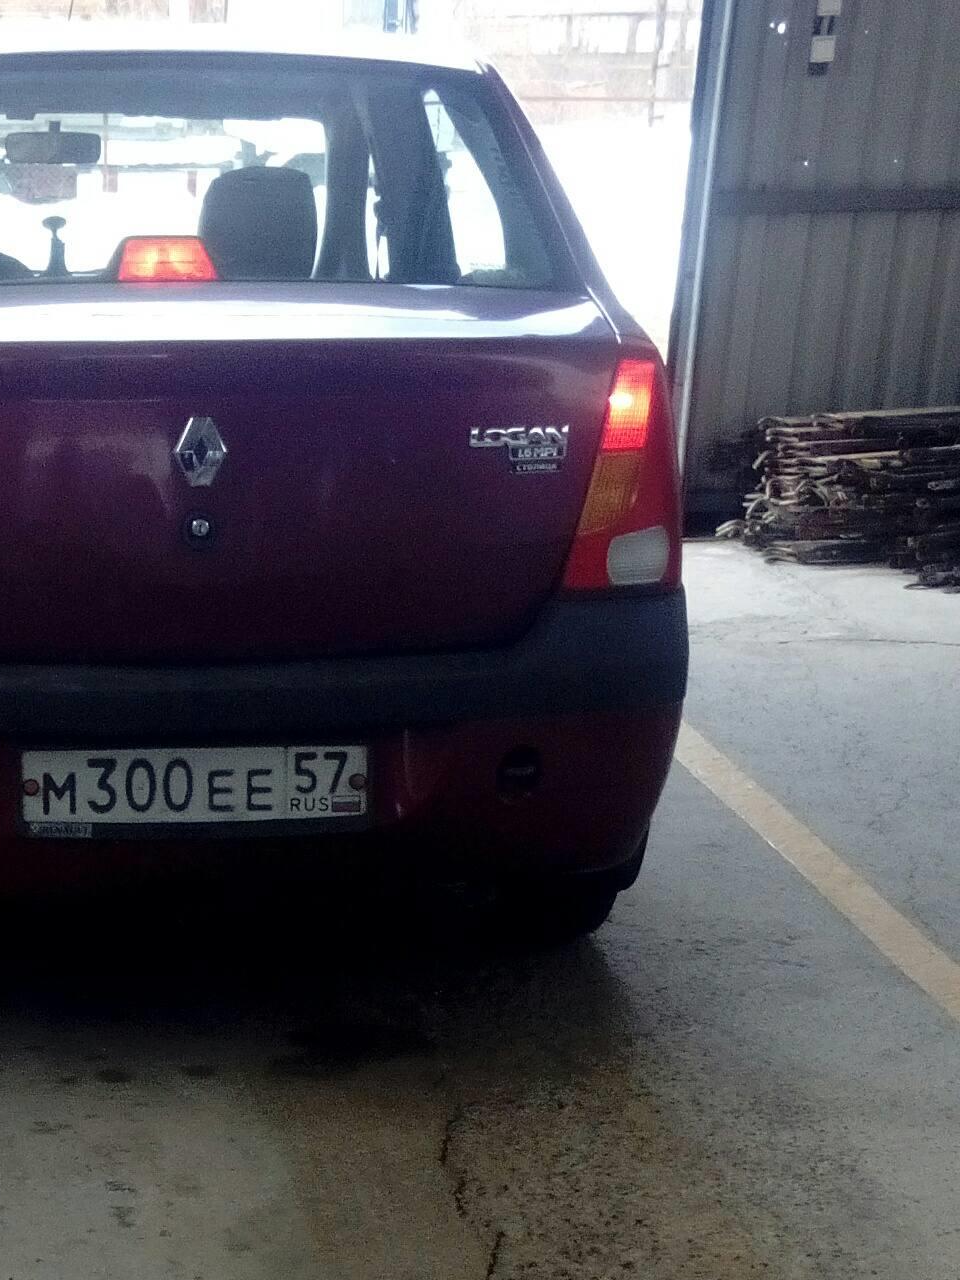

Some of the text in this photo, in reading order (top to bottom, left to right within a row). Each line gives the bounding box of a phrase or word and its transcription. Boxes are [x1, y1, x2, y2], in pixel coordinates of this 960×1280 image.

[469, 425, 569, 448] LOGAN
[294, 751, 348, 794] 57
[290, 797, 329, 812] RUS
